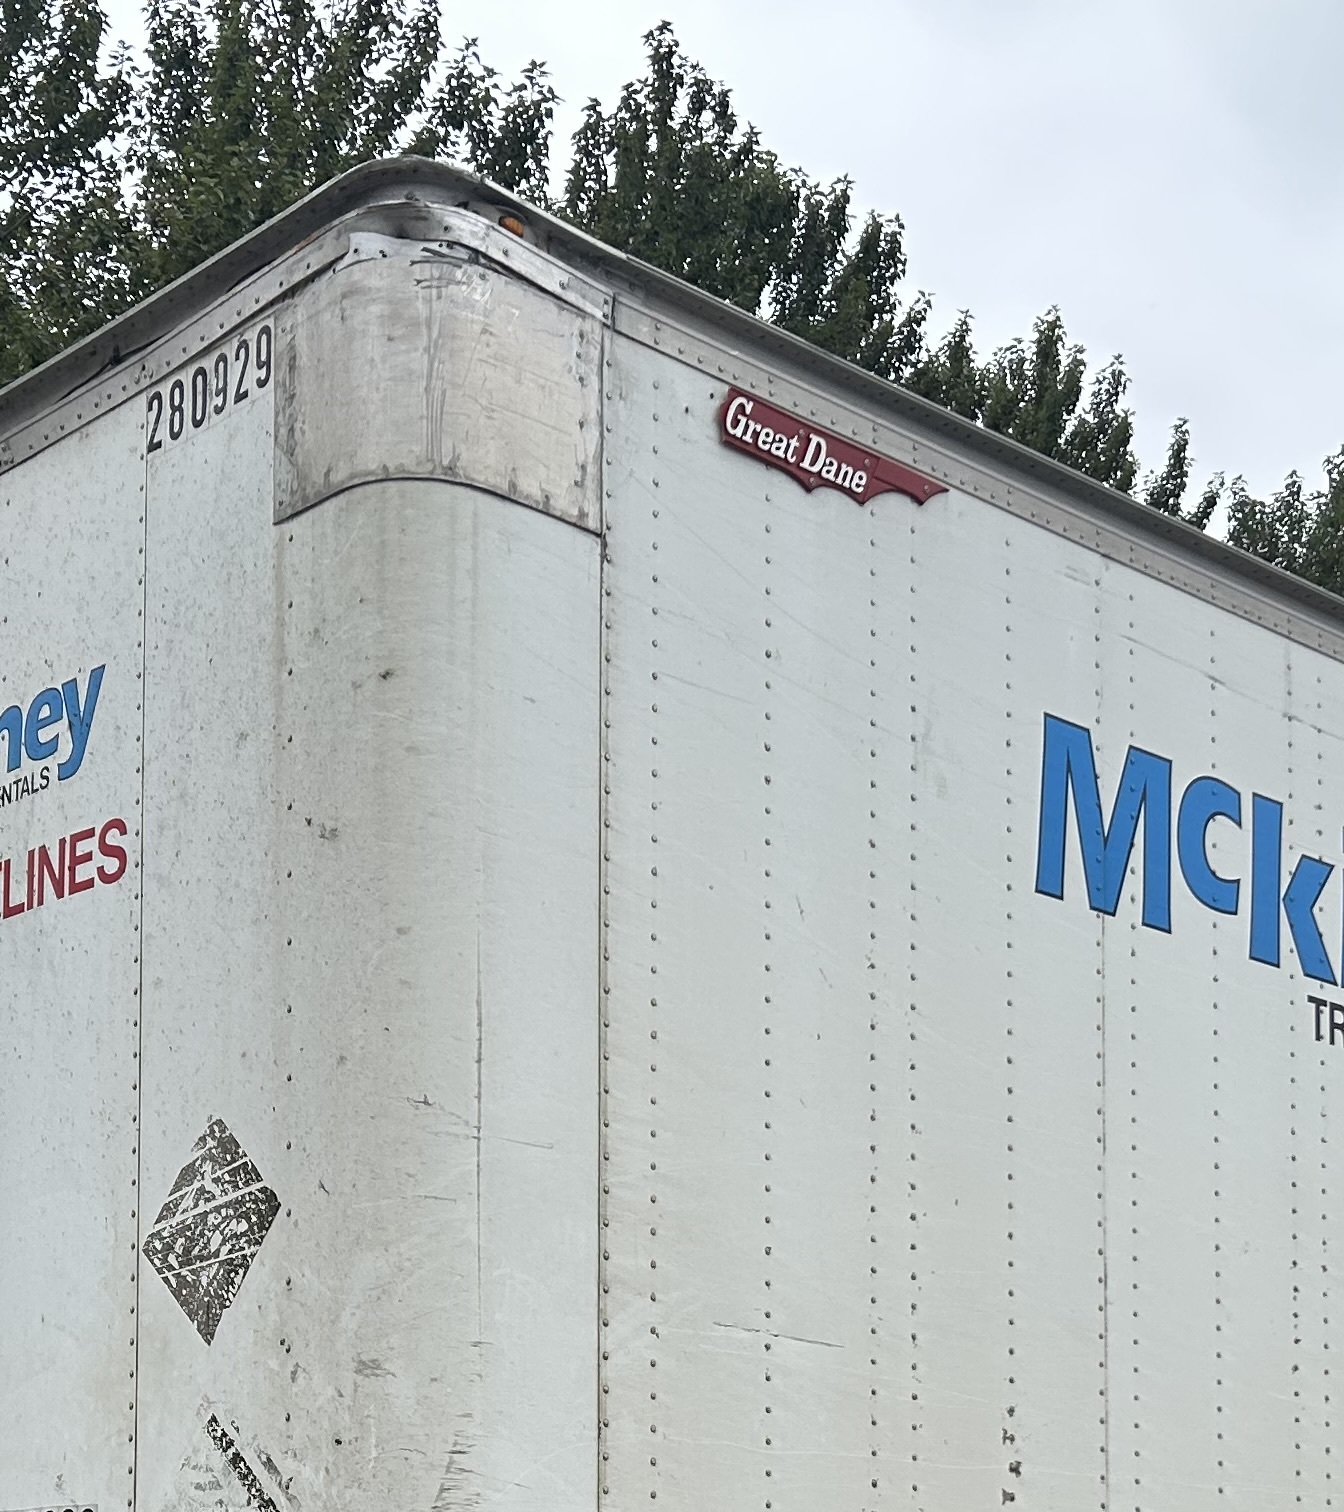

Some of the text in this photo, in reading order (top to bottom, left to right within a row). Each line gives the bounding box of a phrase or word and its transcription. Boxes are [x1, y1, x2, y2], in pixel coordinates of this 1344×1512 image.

[147, 324, 272, 455] 280929
[725, 396, 868, 494] Great Dane
